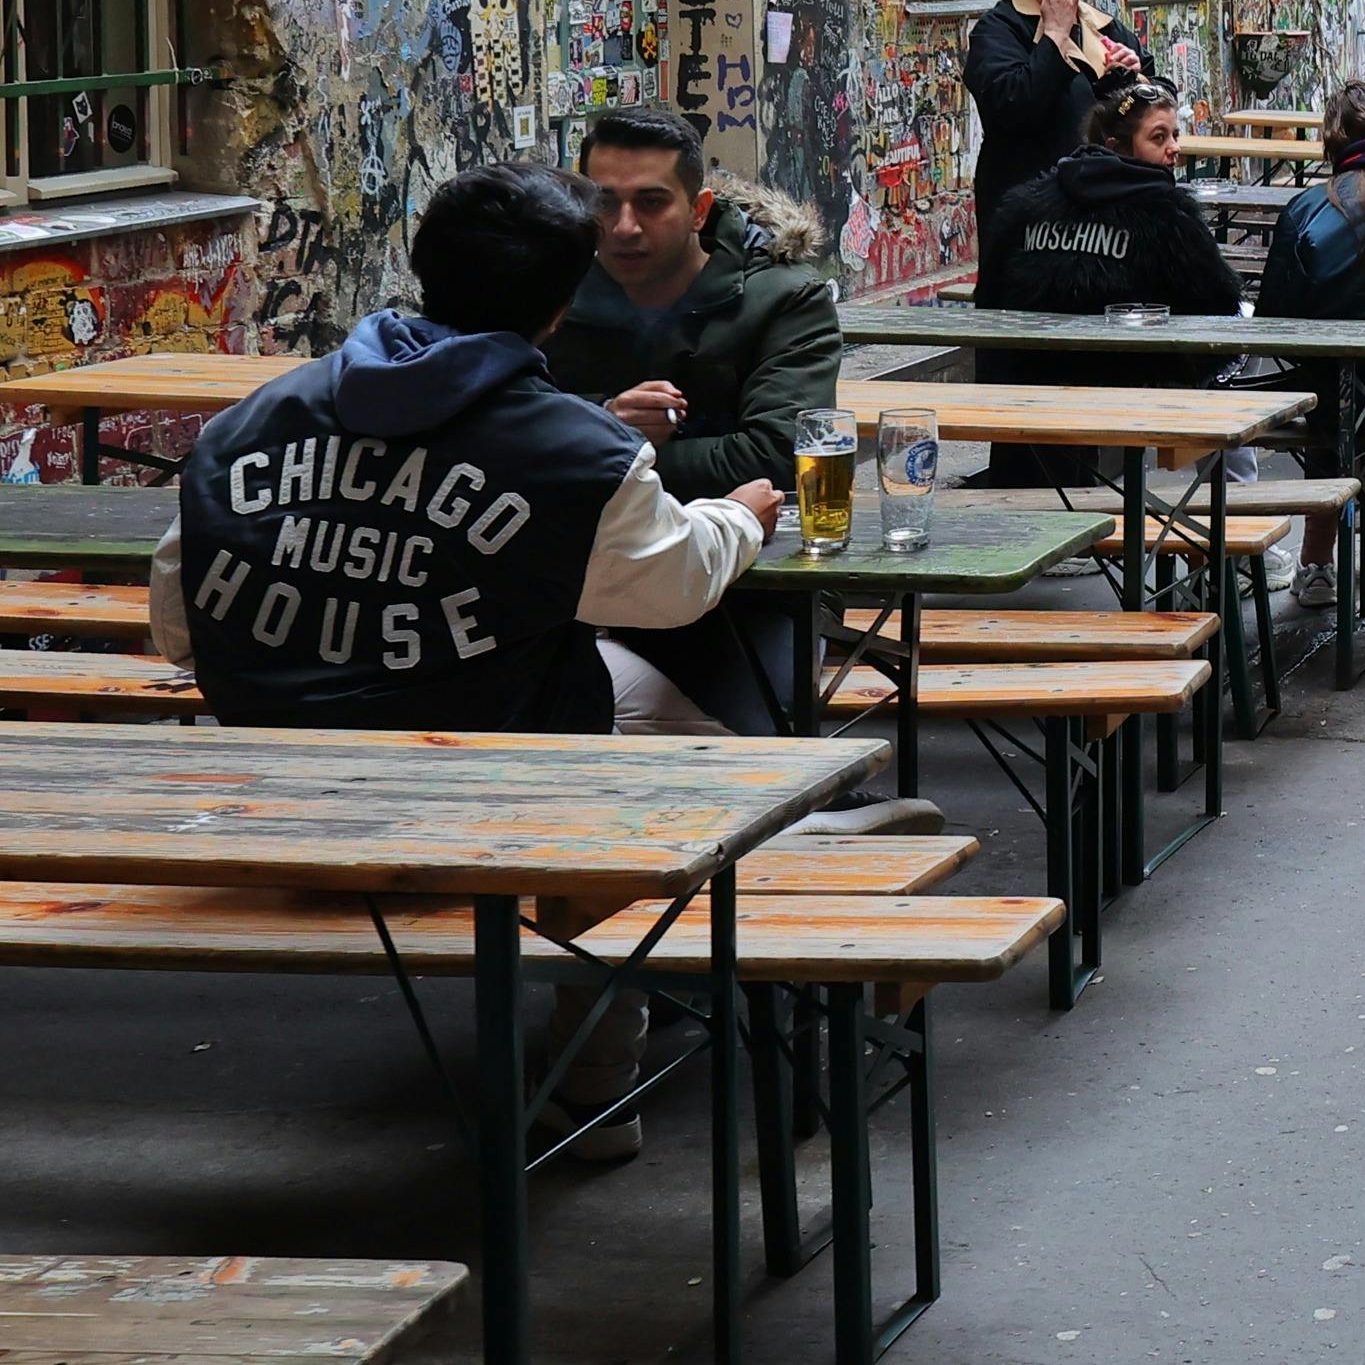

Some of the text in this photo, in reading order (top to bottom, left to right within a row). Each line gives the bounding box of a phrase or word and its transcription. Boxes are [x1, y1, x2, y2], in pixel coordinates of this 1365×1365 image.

[1024, 221, 1129, 259] MOSCHINO
[230, 435, 531, 555] CHICAGO
[271, 515, 434, 587] MUSIC
[194, 549, 498, 669] HOUSE
